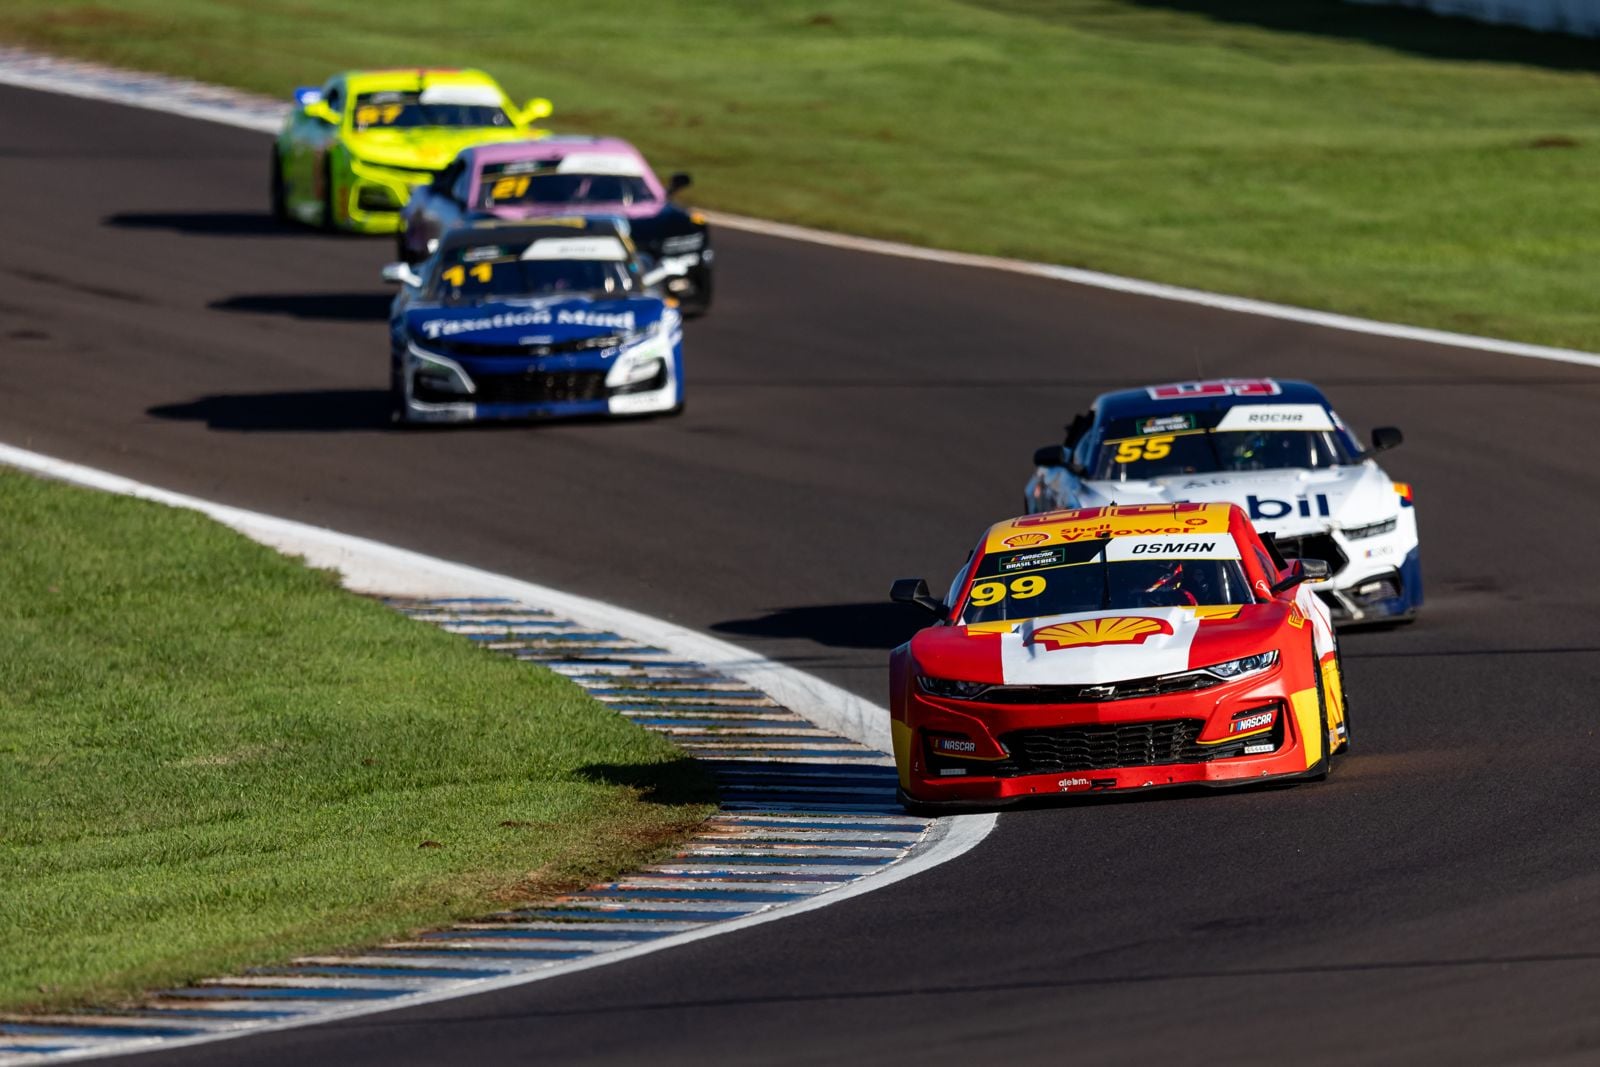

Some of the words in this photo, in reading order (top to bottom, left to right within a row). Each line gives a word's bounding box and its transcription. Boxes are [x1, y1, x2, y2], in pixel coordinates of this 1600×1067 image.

[491, 176, 531, 199] 21
[442, 262, 493, 287] 11
[1248, 413, 1303, 423] ROCHA
[1115, 435, 1175, 463] 55
[1247, 494, 1330, 520] bil
[1020, 551, 1054, 561] NASCAR
[1132, 542, 1216, 554] OSMAN
[1006, 562, 1031, 570] BRASIL
[1033, 557, 1057, 565] SERIES
[970, 575, 1047, 607] 99
[1240, 712, 1272, 730] NASCAR
[944, 740, 976, 752] NASCAR
